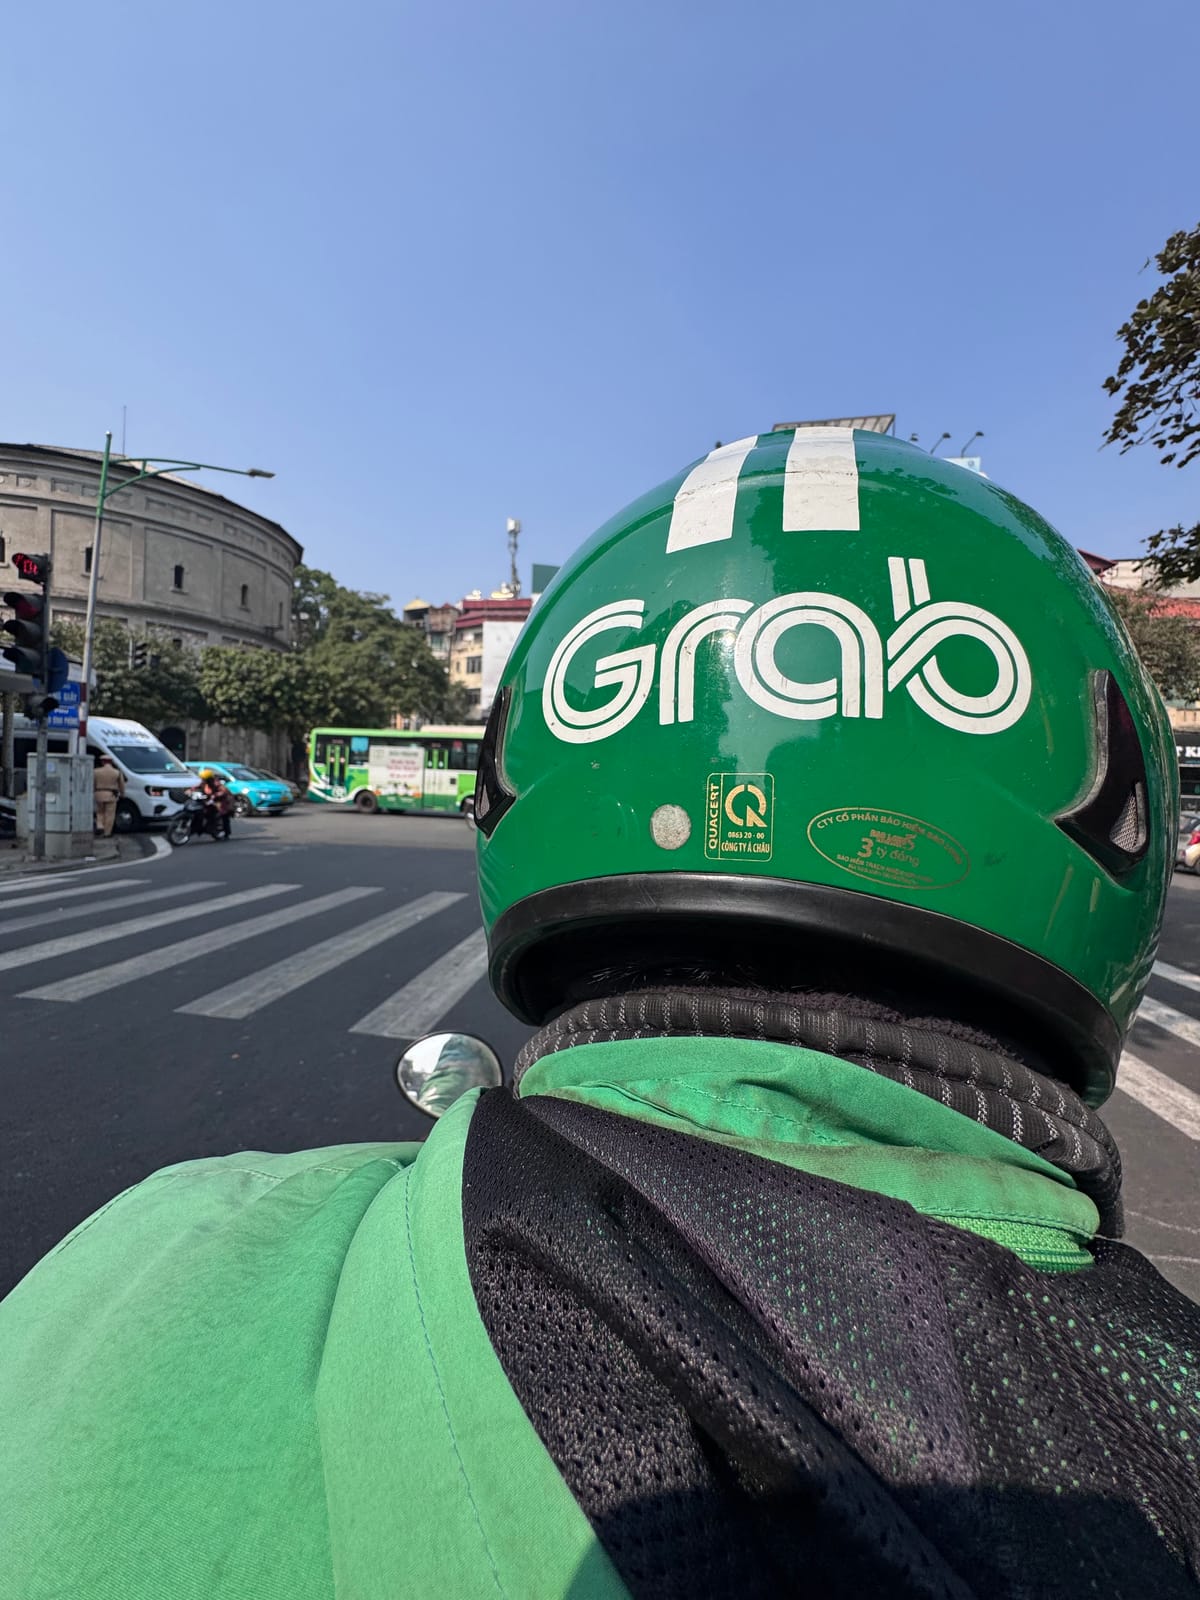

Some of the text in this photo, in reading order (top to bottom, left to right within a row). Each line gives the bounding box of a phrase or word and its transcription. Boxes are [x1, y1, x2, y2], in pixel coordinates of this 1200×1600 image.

[542, 556, 1032, 744] Grab
[708, 783, 719, 850] QUACERT
[816, 817, 834, 829] CTY
[739, 842, 747, 852] TY
[857, 837, 874, 858] 3
